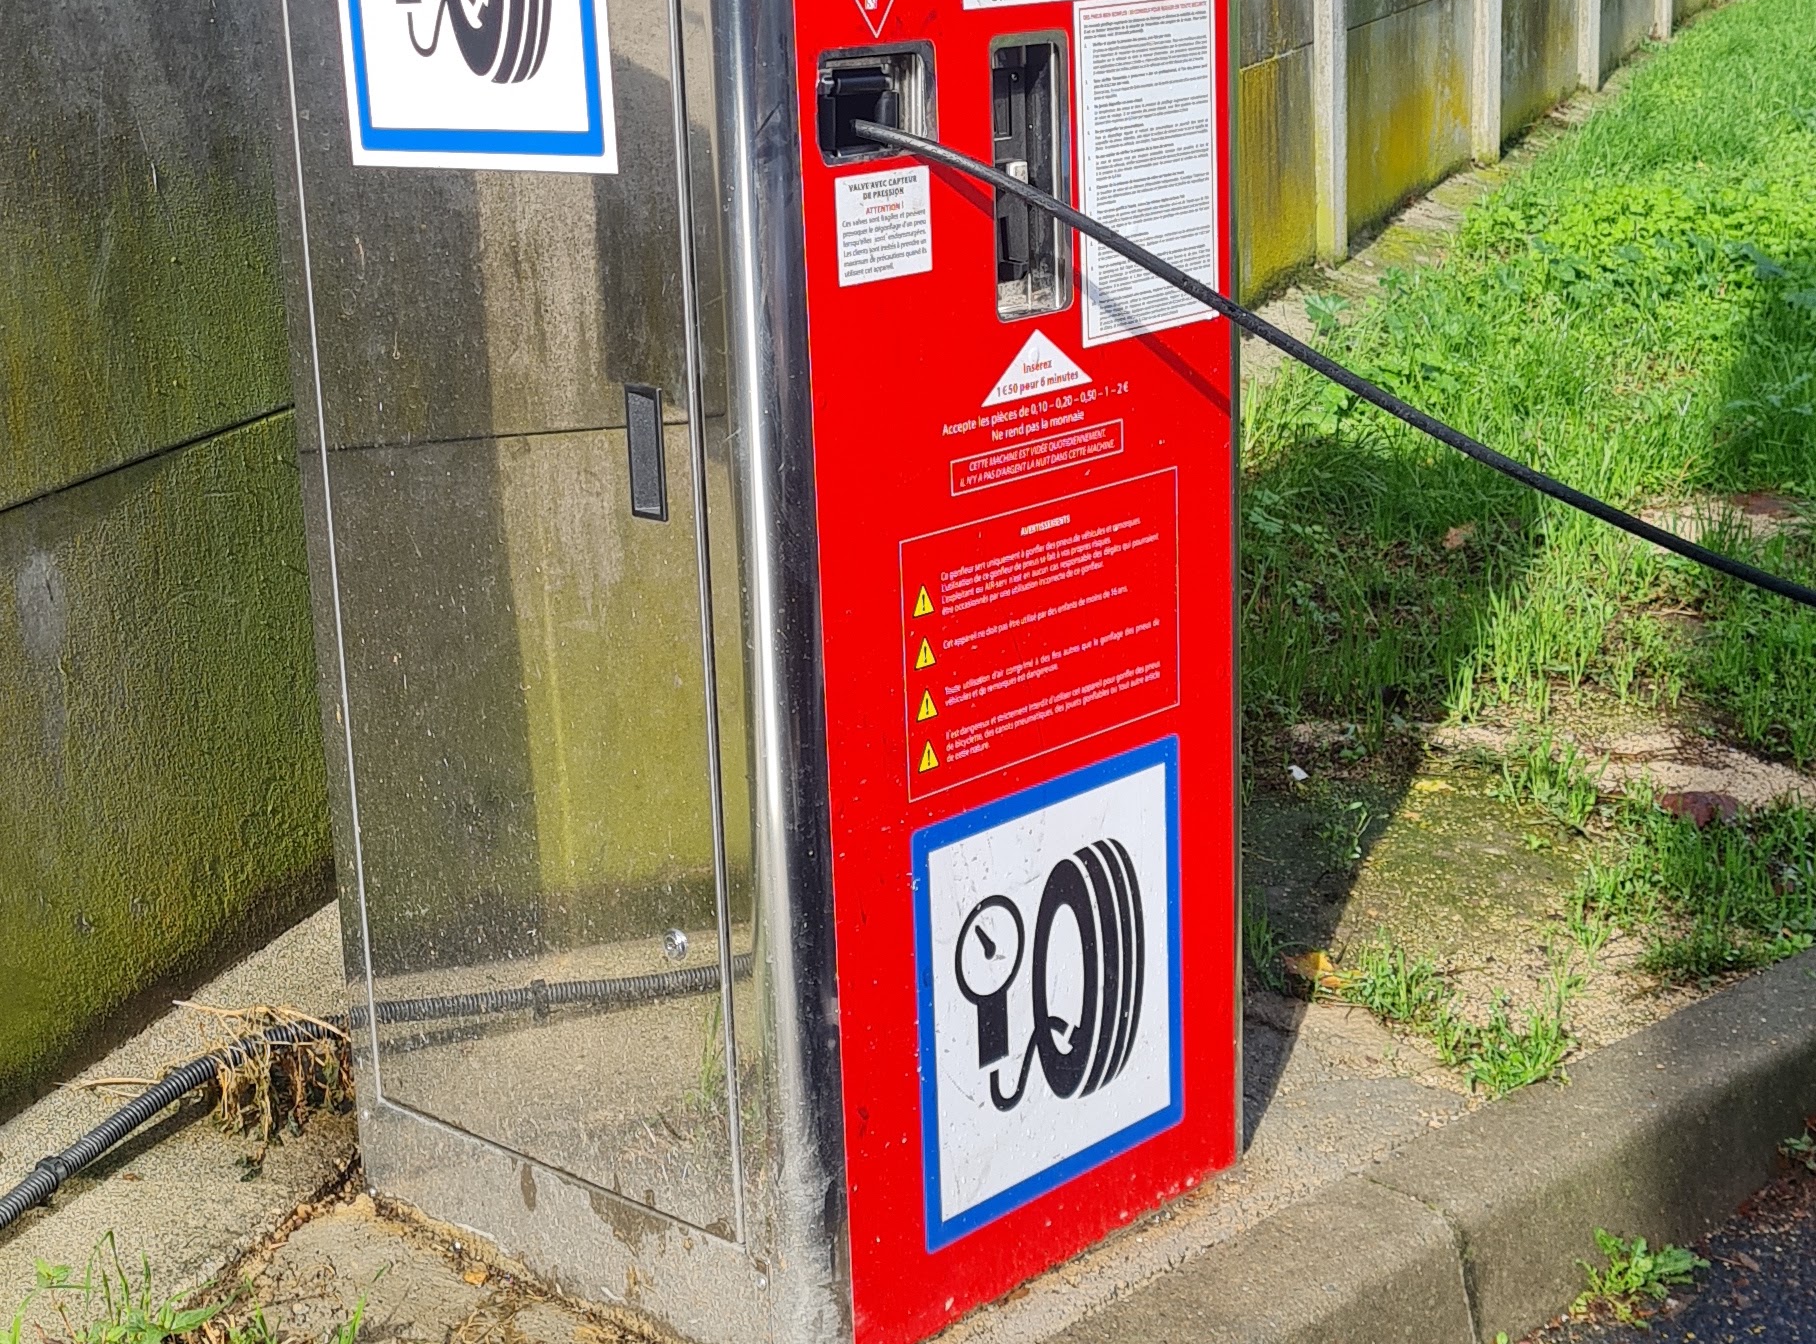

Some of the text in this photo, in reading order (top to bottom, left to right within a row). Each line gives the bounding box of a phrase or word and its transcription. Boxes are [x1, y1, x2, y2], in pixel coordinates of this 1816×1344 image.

[849, 175, 917, 192] VALVE AVEC CAPTEUR
[863, 188, 904, 200] DE PRESSION
[866, 203, 900, 215] ATTENTION
[1020, 379, 1039, 395] pour
[1040, 376, 1045, 386] 6
[1047, 371, 1079, 386] minutes
[942, 420, 977, 436] Accepte
[978, 415, 989, 427] les
[991, 409, 1018, 427] pièces
[1018, 404, 1030, 417] de
[991, 410, 1085, 442] Ne rend pas la monnaie
[969, 457, 988, 471] CETTE
[989, 451, 1018, 466] MACHINE
[1019, 447, 1030, 458] EST
[983, 470, 996, 480] PAS
[1027, 459, 1035, 470] LA
[1036, 456, 1050, 467] NUIT
[1051, 451, 1068, 463] DANS
[1069, 446, 1086, 459] CETTE
